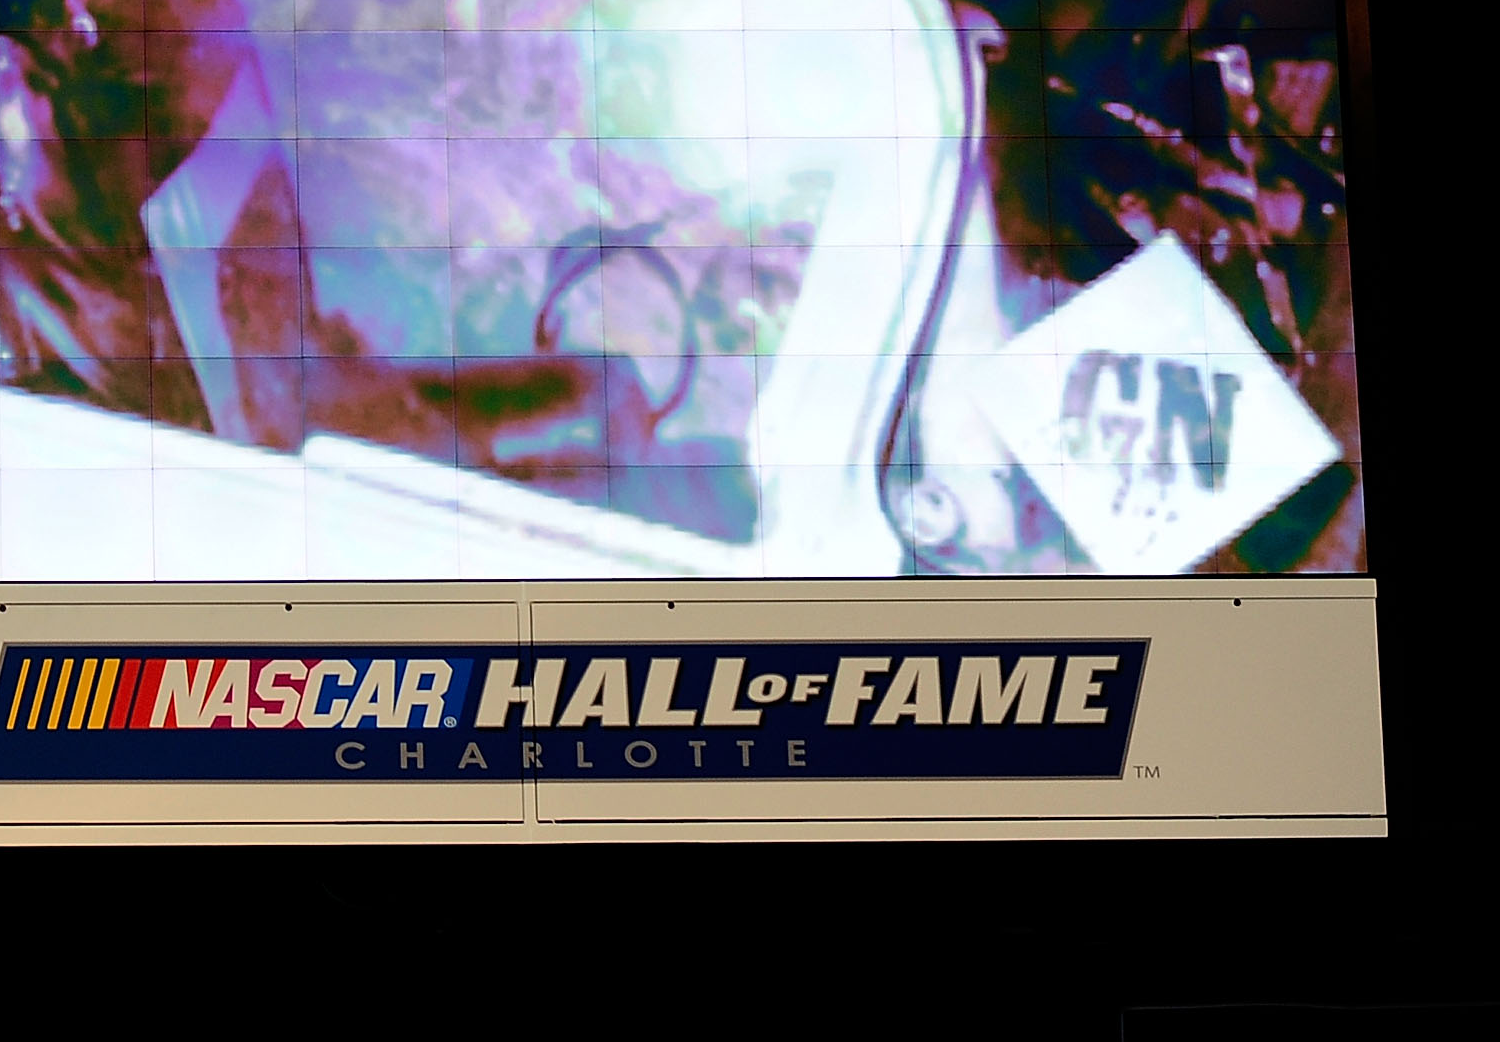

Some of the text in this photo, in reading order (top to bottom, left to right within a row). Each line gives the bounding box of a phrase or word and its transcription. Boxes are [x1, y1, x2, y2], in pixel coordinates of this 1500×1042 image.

[474, 658, 763, 727] HALL
[746, 673, 830, 704] OF
[823, 655, 1120, 725] FAME
[334, 739, 807, 770] CHARLOTTE
